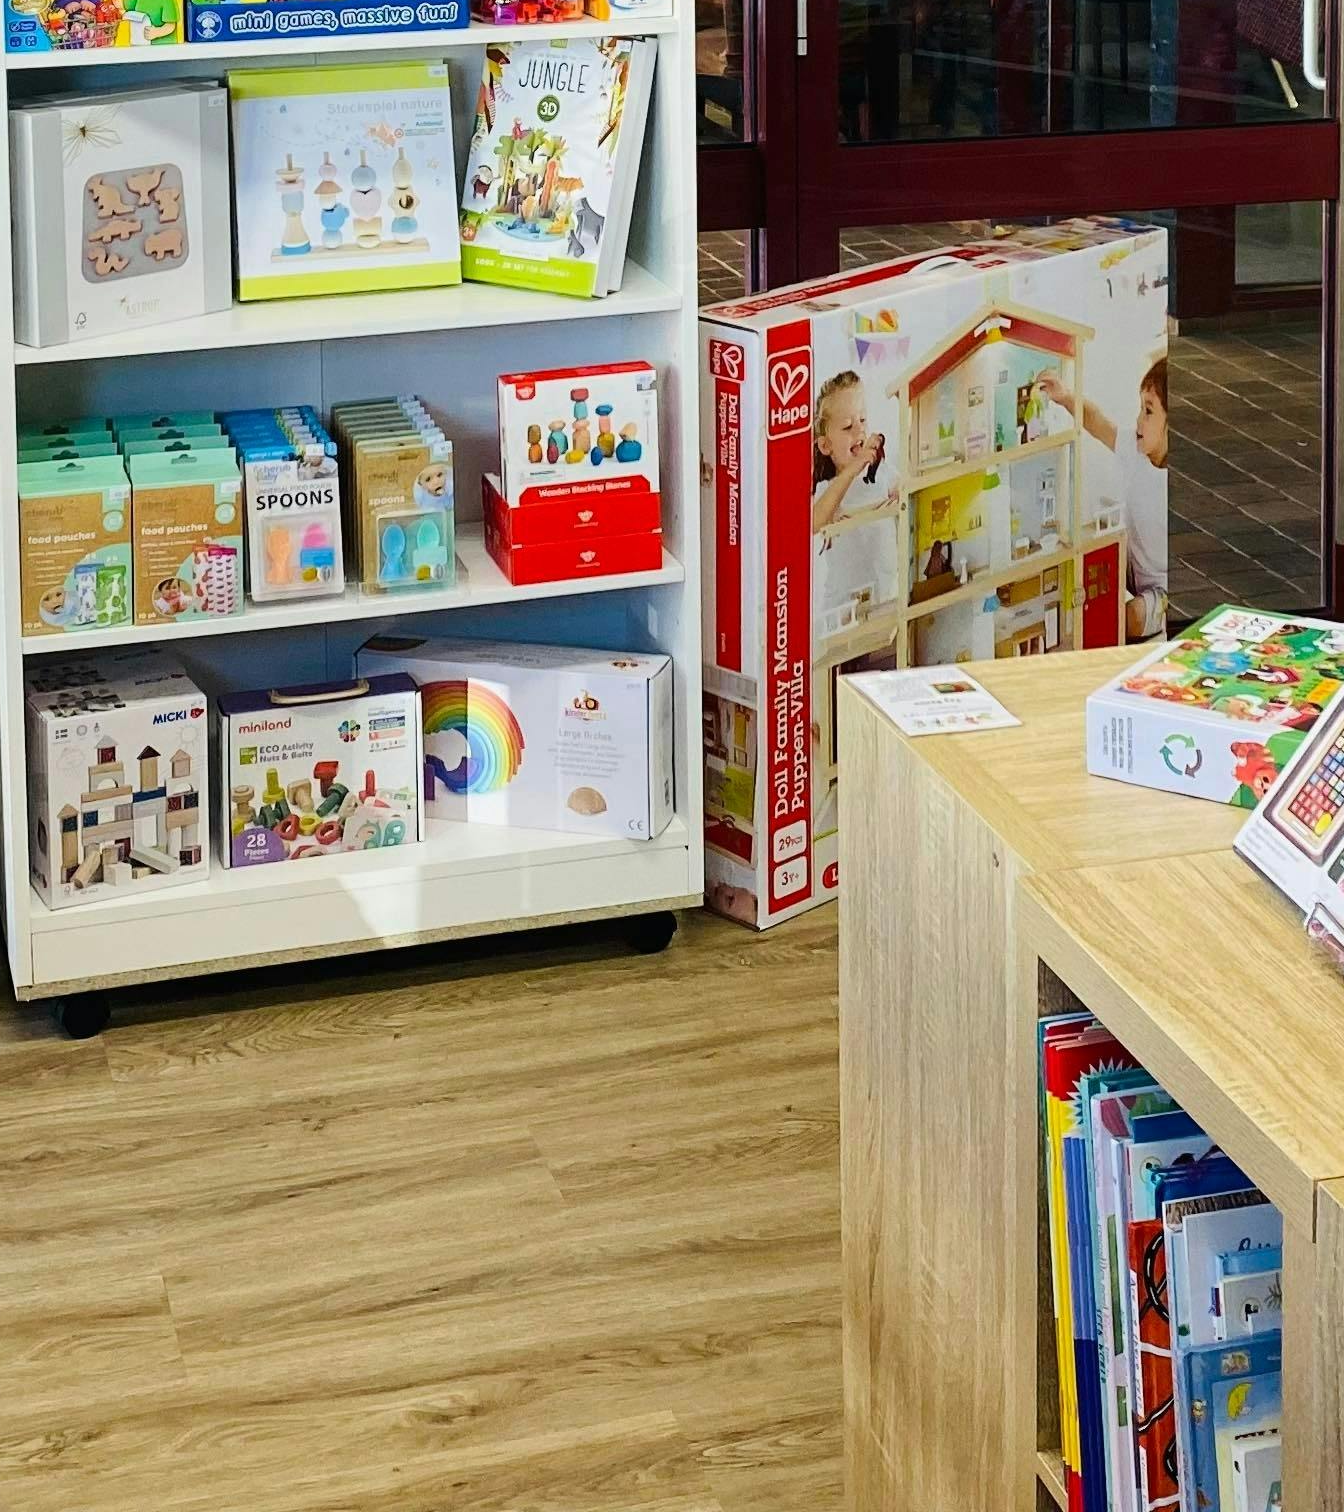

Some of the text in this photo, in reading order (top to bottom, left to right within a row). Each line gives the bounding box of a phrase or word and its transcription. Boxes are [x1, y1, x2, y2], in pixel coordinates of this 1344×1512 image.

[229, 0, 459, 34] mini games, massive fun!
[518, 59, 590, 94] JUNGLE
[539, 101, 557, 116] 3D
[713, 341, 722, 375] Hape
[770, 402, 809, 426] Hape
[728, 392, 739, 546] Doll Family Mansion
[256, 489, 334, 510] SPOONS
[368, 494, 405, 506] spoons
[539, 486, 571, 499] Wooden
[27, 531, 97, 545] food pouches
[140, 523, 208, 536] food pouches
[773, 566, 791, 820] Doll Family Mansion
[152, 709, 188, 726] MICKI
[238, 717, 293, 735] miniland
[558, 727, 581, 740] Large
[790, 658, 806, 813] Puppen-Villa
[259, 741, 315, 754] ECO Activity
[259, 753, 281, 764] Nuts
[246, 833, 268, 848] 28
